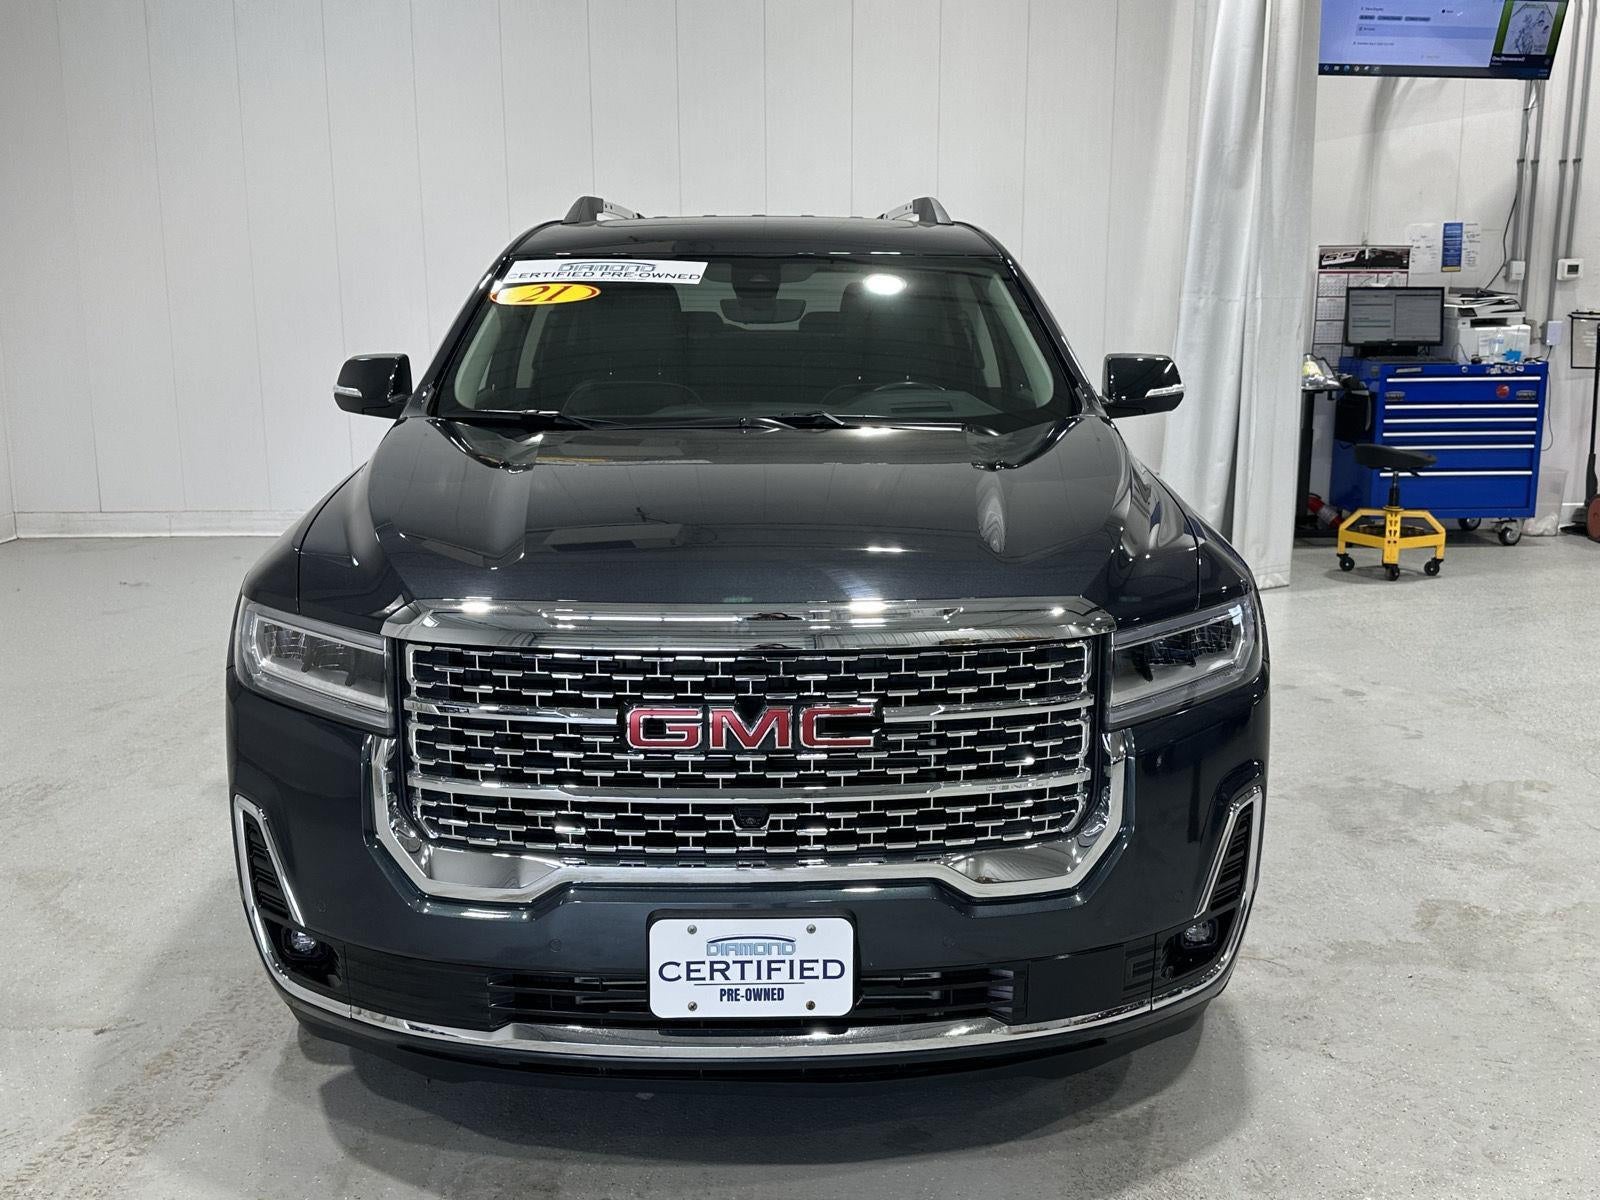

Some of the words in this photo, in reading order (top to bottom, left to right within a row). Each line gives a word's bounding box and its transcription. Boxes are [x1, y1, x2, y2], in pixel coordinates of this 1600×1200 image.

[508, 271, 595, 279] CERTIFIED
[600, 271, 701, 280] PRE-OWNED
[558, 263, 656, 273] DIAMOND
[516, 285, 573, 302] 21
[626, 705, 875, 750] GMC
[706, 942, 797, 957] DIAMOND
[658, 958, 846, 982] CERTIFIED
[719, 987, 785, 1002] PRE-OWNED
